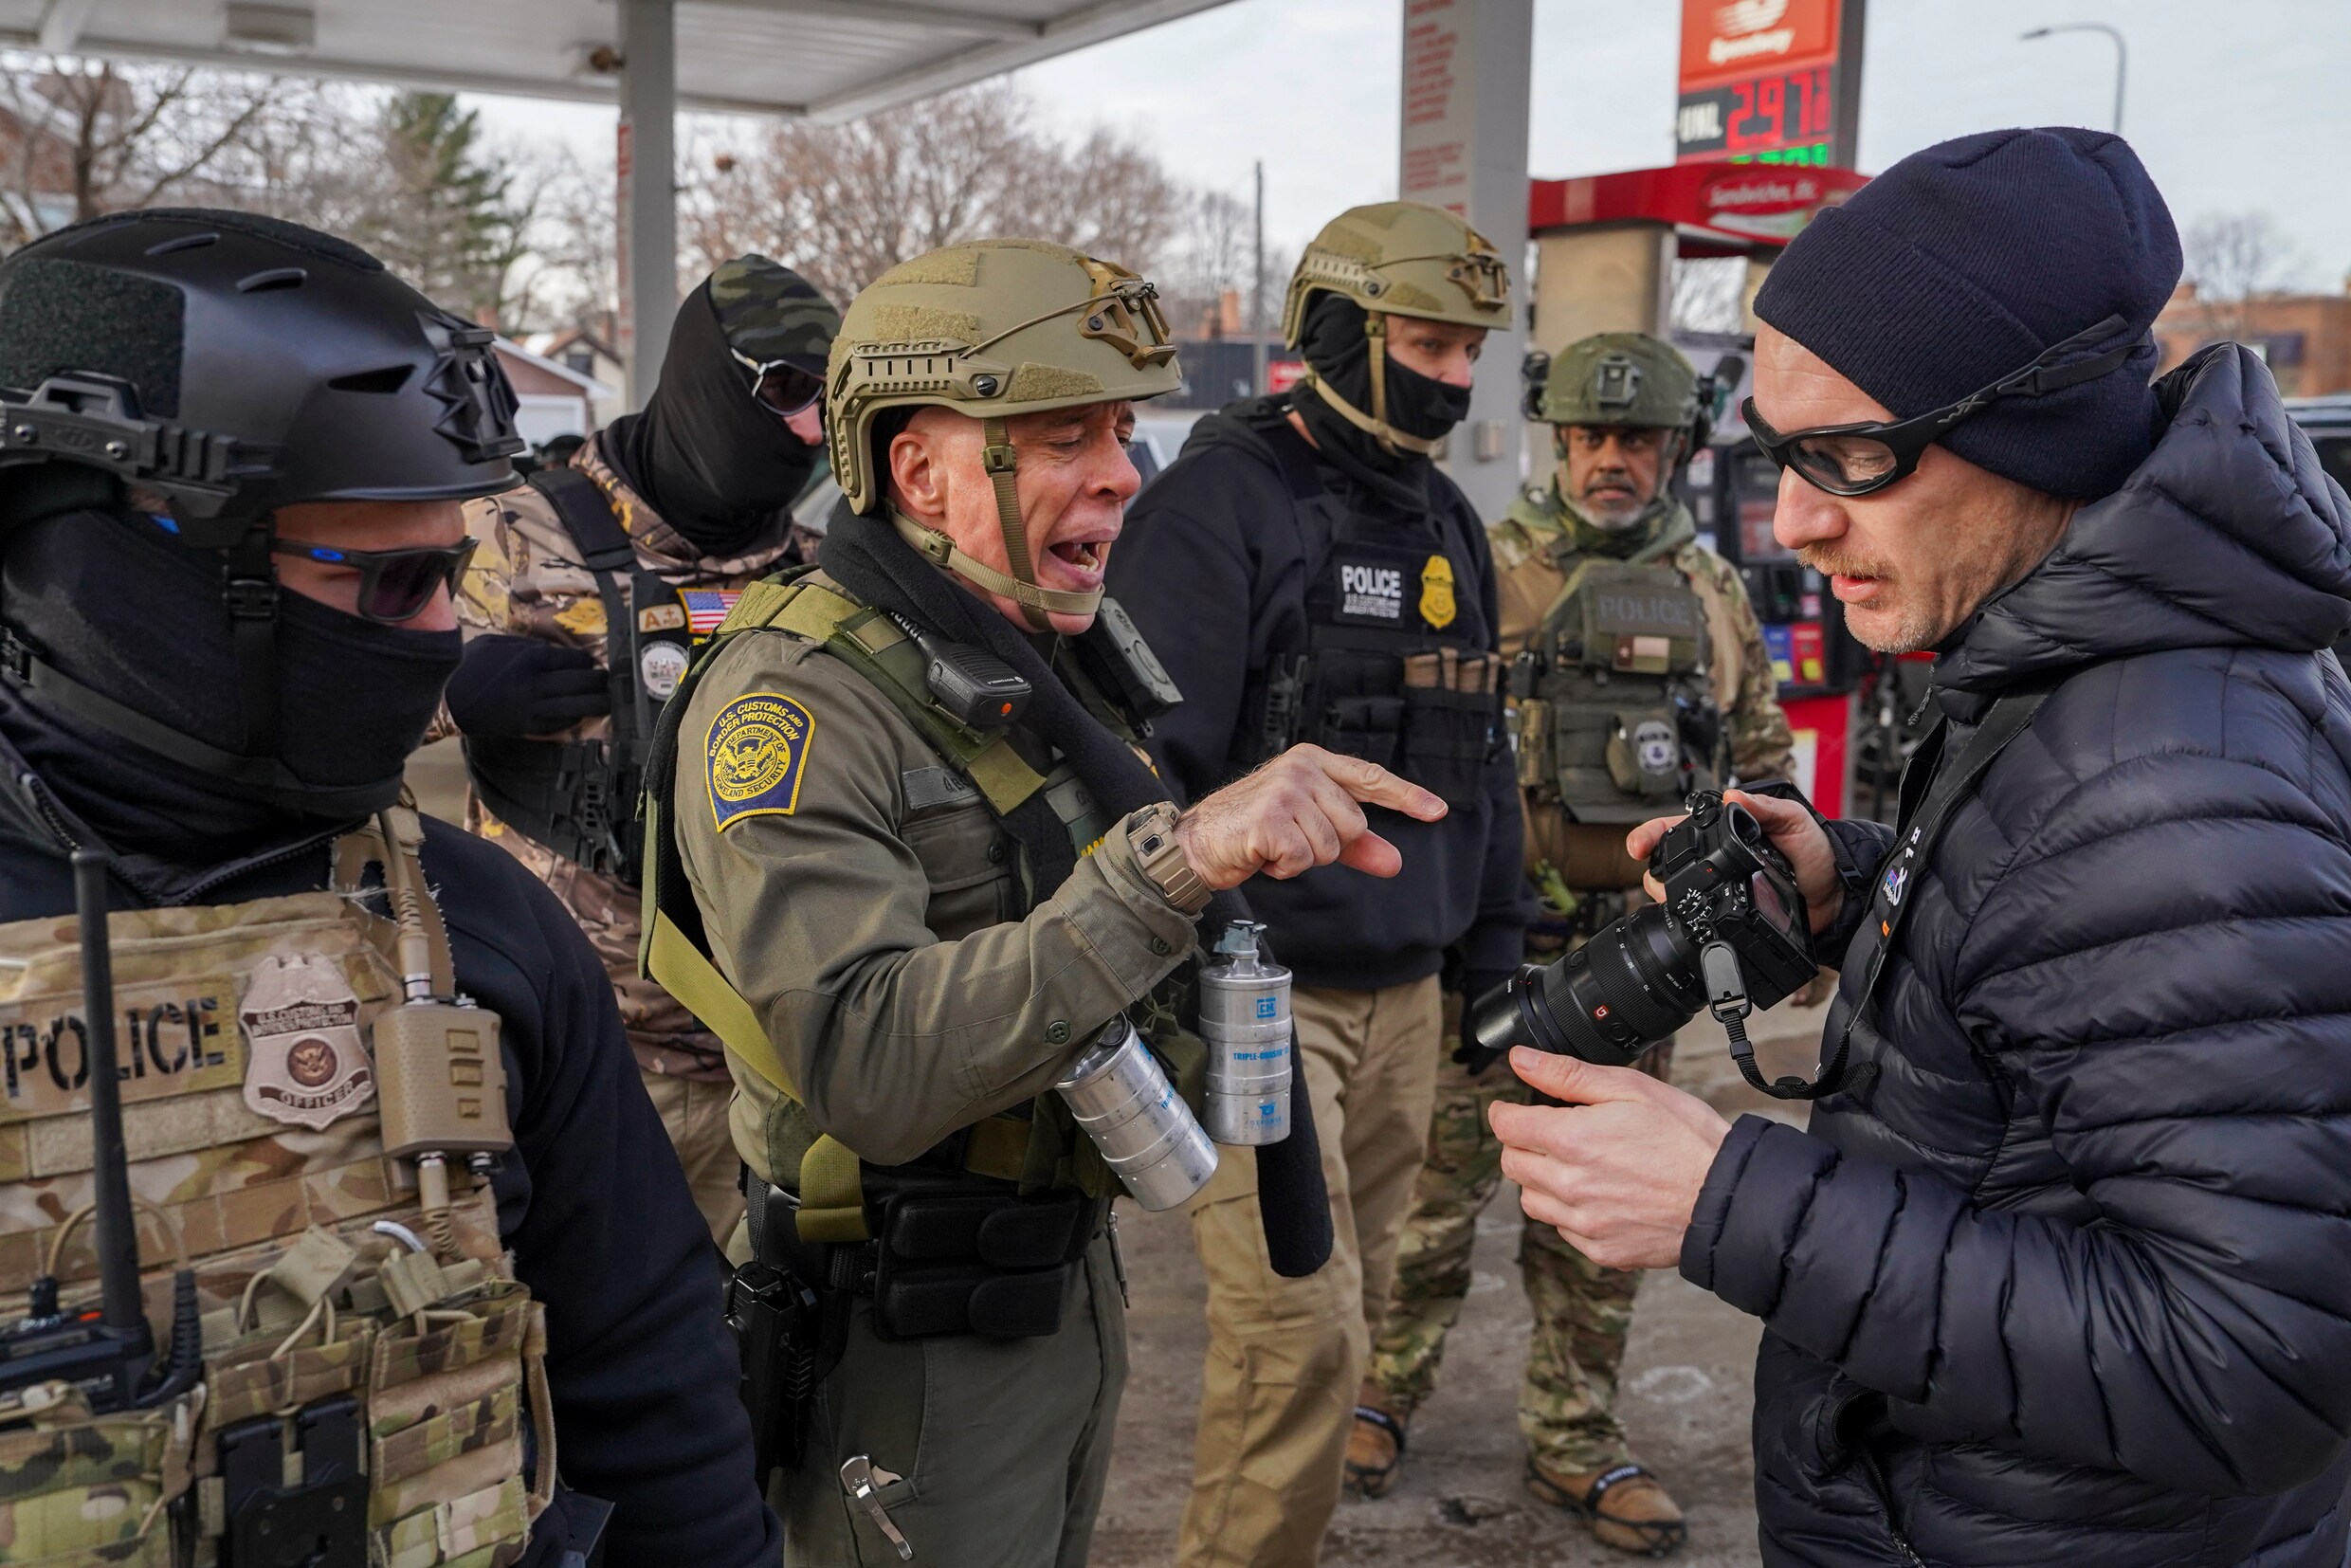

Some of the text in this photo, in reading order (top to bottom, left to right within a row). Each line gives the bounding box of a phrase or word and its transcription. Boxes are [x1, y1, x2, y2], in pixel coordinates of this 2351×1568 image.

[1341, 564, 1402, 599] POLICE
[1599, 595, 1688, 625] POLICE
[719, 701, 804, 728] U.S. CUSTOMS AND
[709, 712, 800, 757] BORDER PROTECTION
[726, 726, 780, 746] DEPARTMENT
[775, 742, 786, 753] OF
[715, 759, 786, 797] HOMELAND SECURITY
[3, 996, 226, 1100] POICE
[279, 1080, 354, 1109] OFFICER
